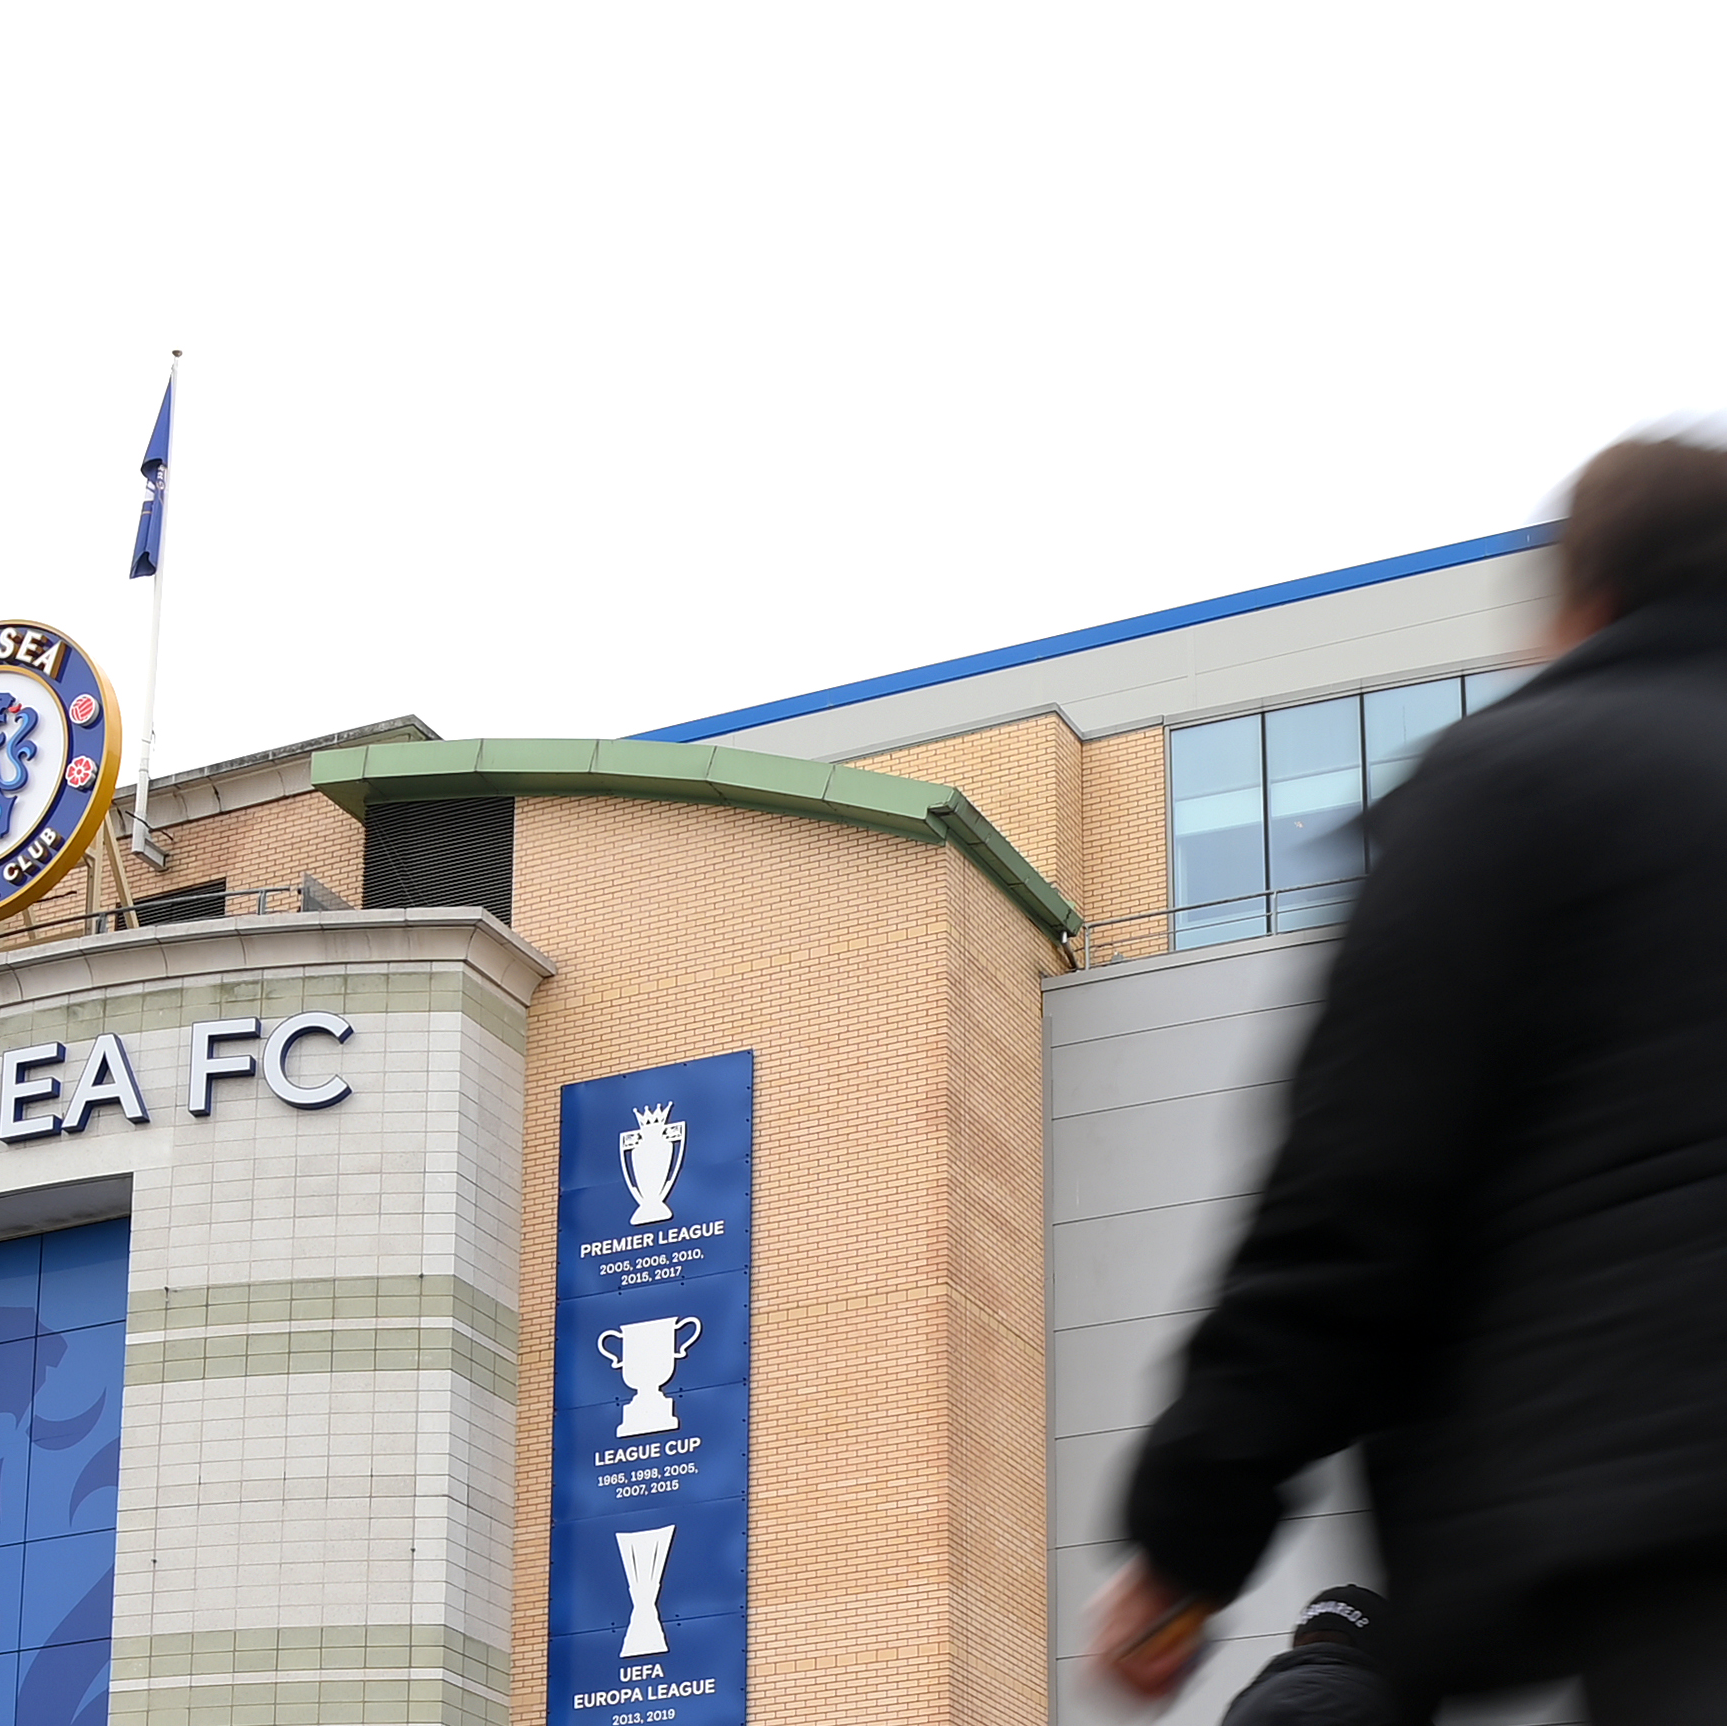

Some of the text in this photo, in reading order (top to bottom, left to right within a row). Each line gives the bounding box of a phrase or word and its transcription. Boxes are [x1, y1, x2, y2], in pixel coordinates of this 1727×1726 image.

[2, 827, 58, 881] CLUB
[188, 1011, 354, 1117] FC
[580, 1220, 724, 1258] PREMIER LEAGUE
[600, 1248, 704, 1275] 2005, 2006, 2010,
[621, 1266, 682, 1285] 2015, 2017
[595, 1437, 701, 1466] LEAGUE CUP
[598, 1463, 698, 1486] 1965, 1998, 2005,
[616, 1480, 679, 1498] 2007, 2015
[620, 1663, 664, 1682] UEFA
[574, 1678, 715, 1709] EUROPA LEAGUE
[612, 1708, 675, 1726] 2013, 2019
